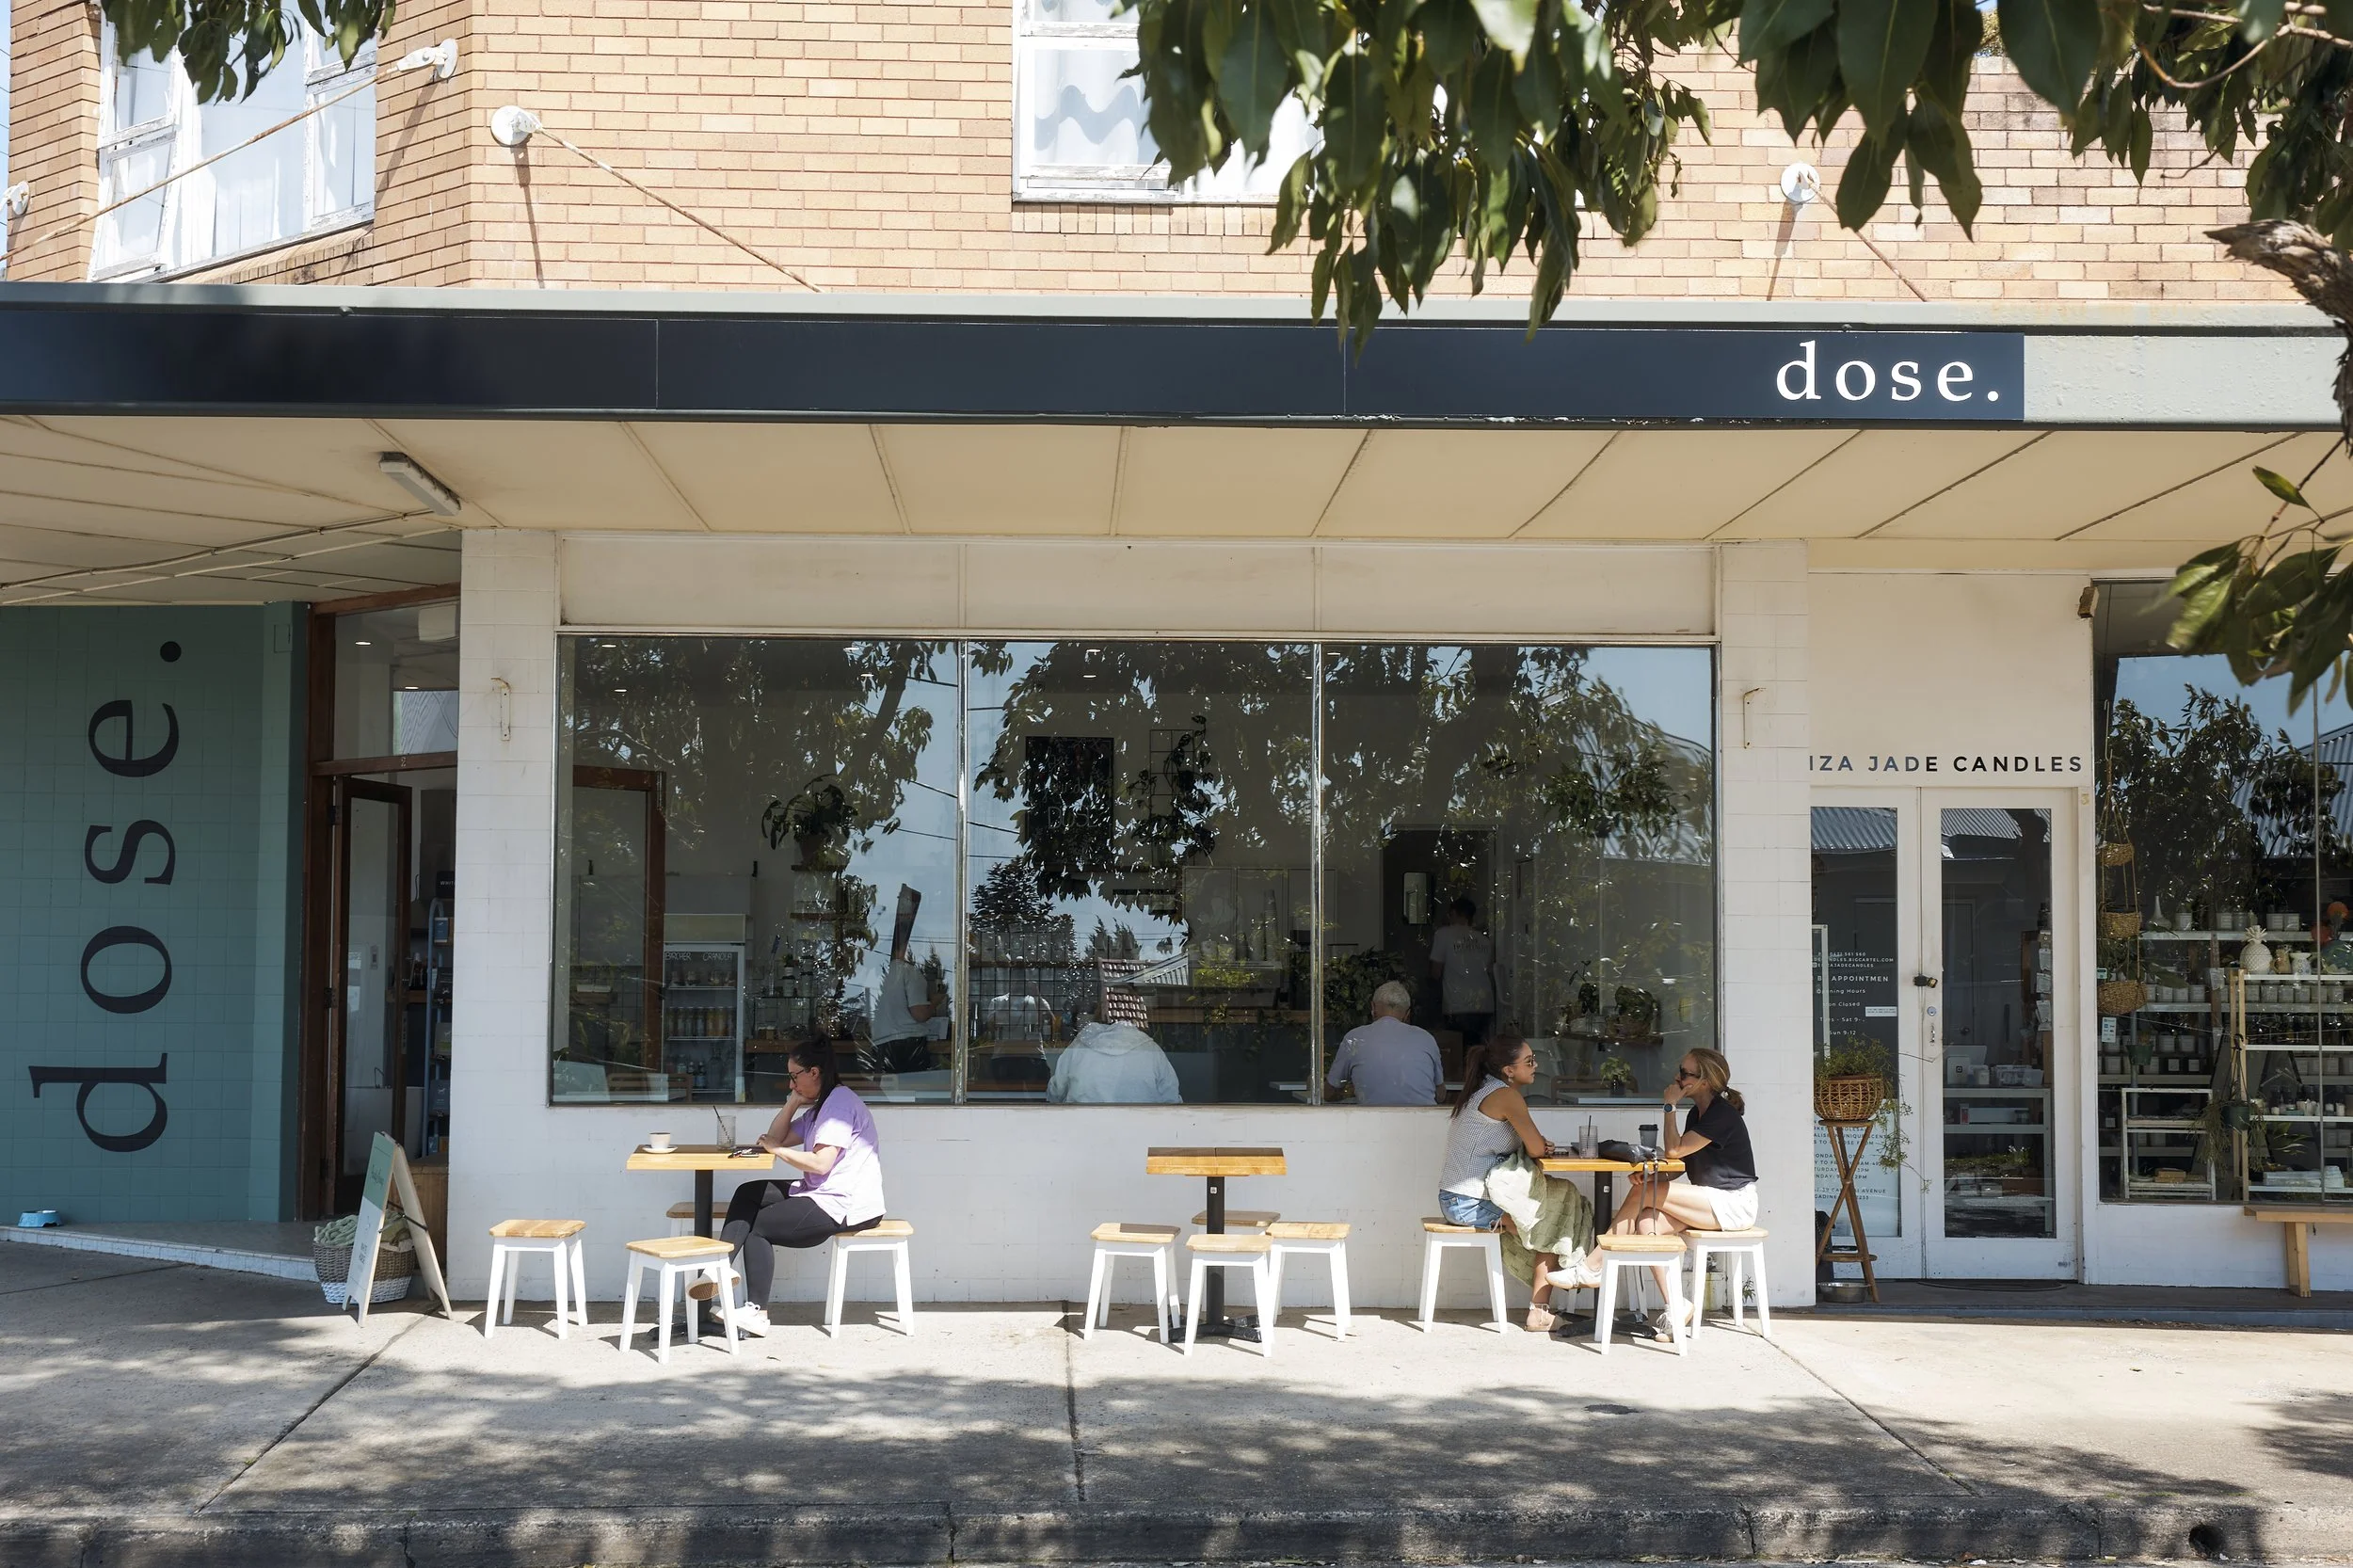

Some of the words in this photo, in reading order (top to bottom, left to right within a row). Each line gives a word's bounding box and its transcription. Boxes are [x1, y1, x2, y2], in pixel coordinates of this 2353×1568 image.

[1776, 340, 1999, 402] dose.
[1809, 755, 1854, 772] IZA
[1868, 756, 1938, 772] JADE
[1953, 756, 2082, 773] CANDLES
[28, 640, 183, 1153] dose.
